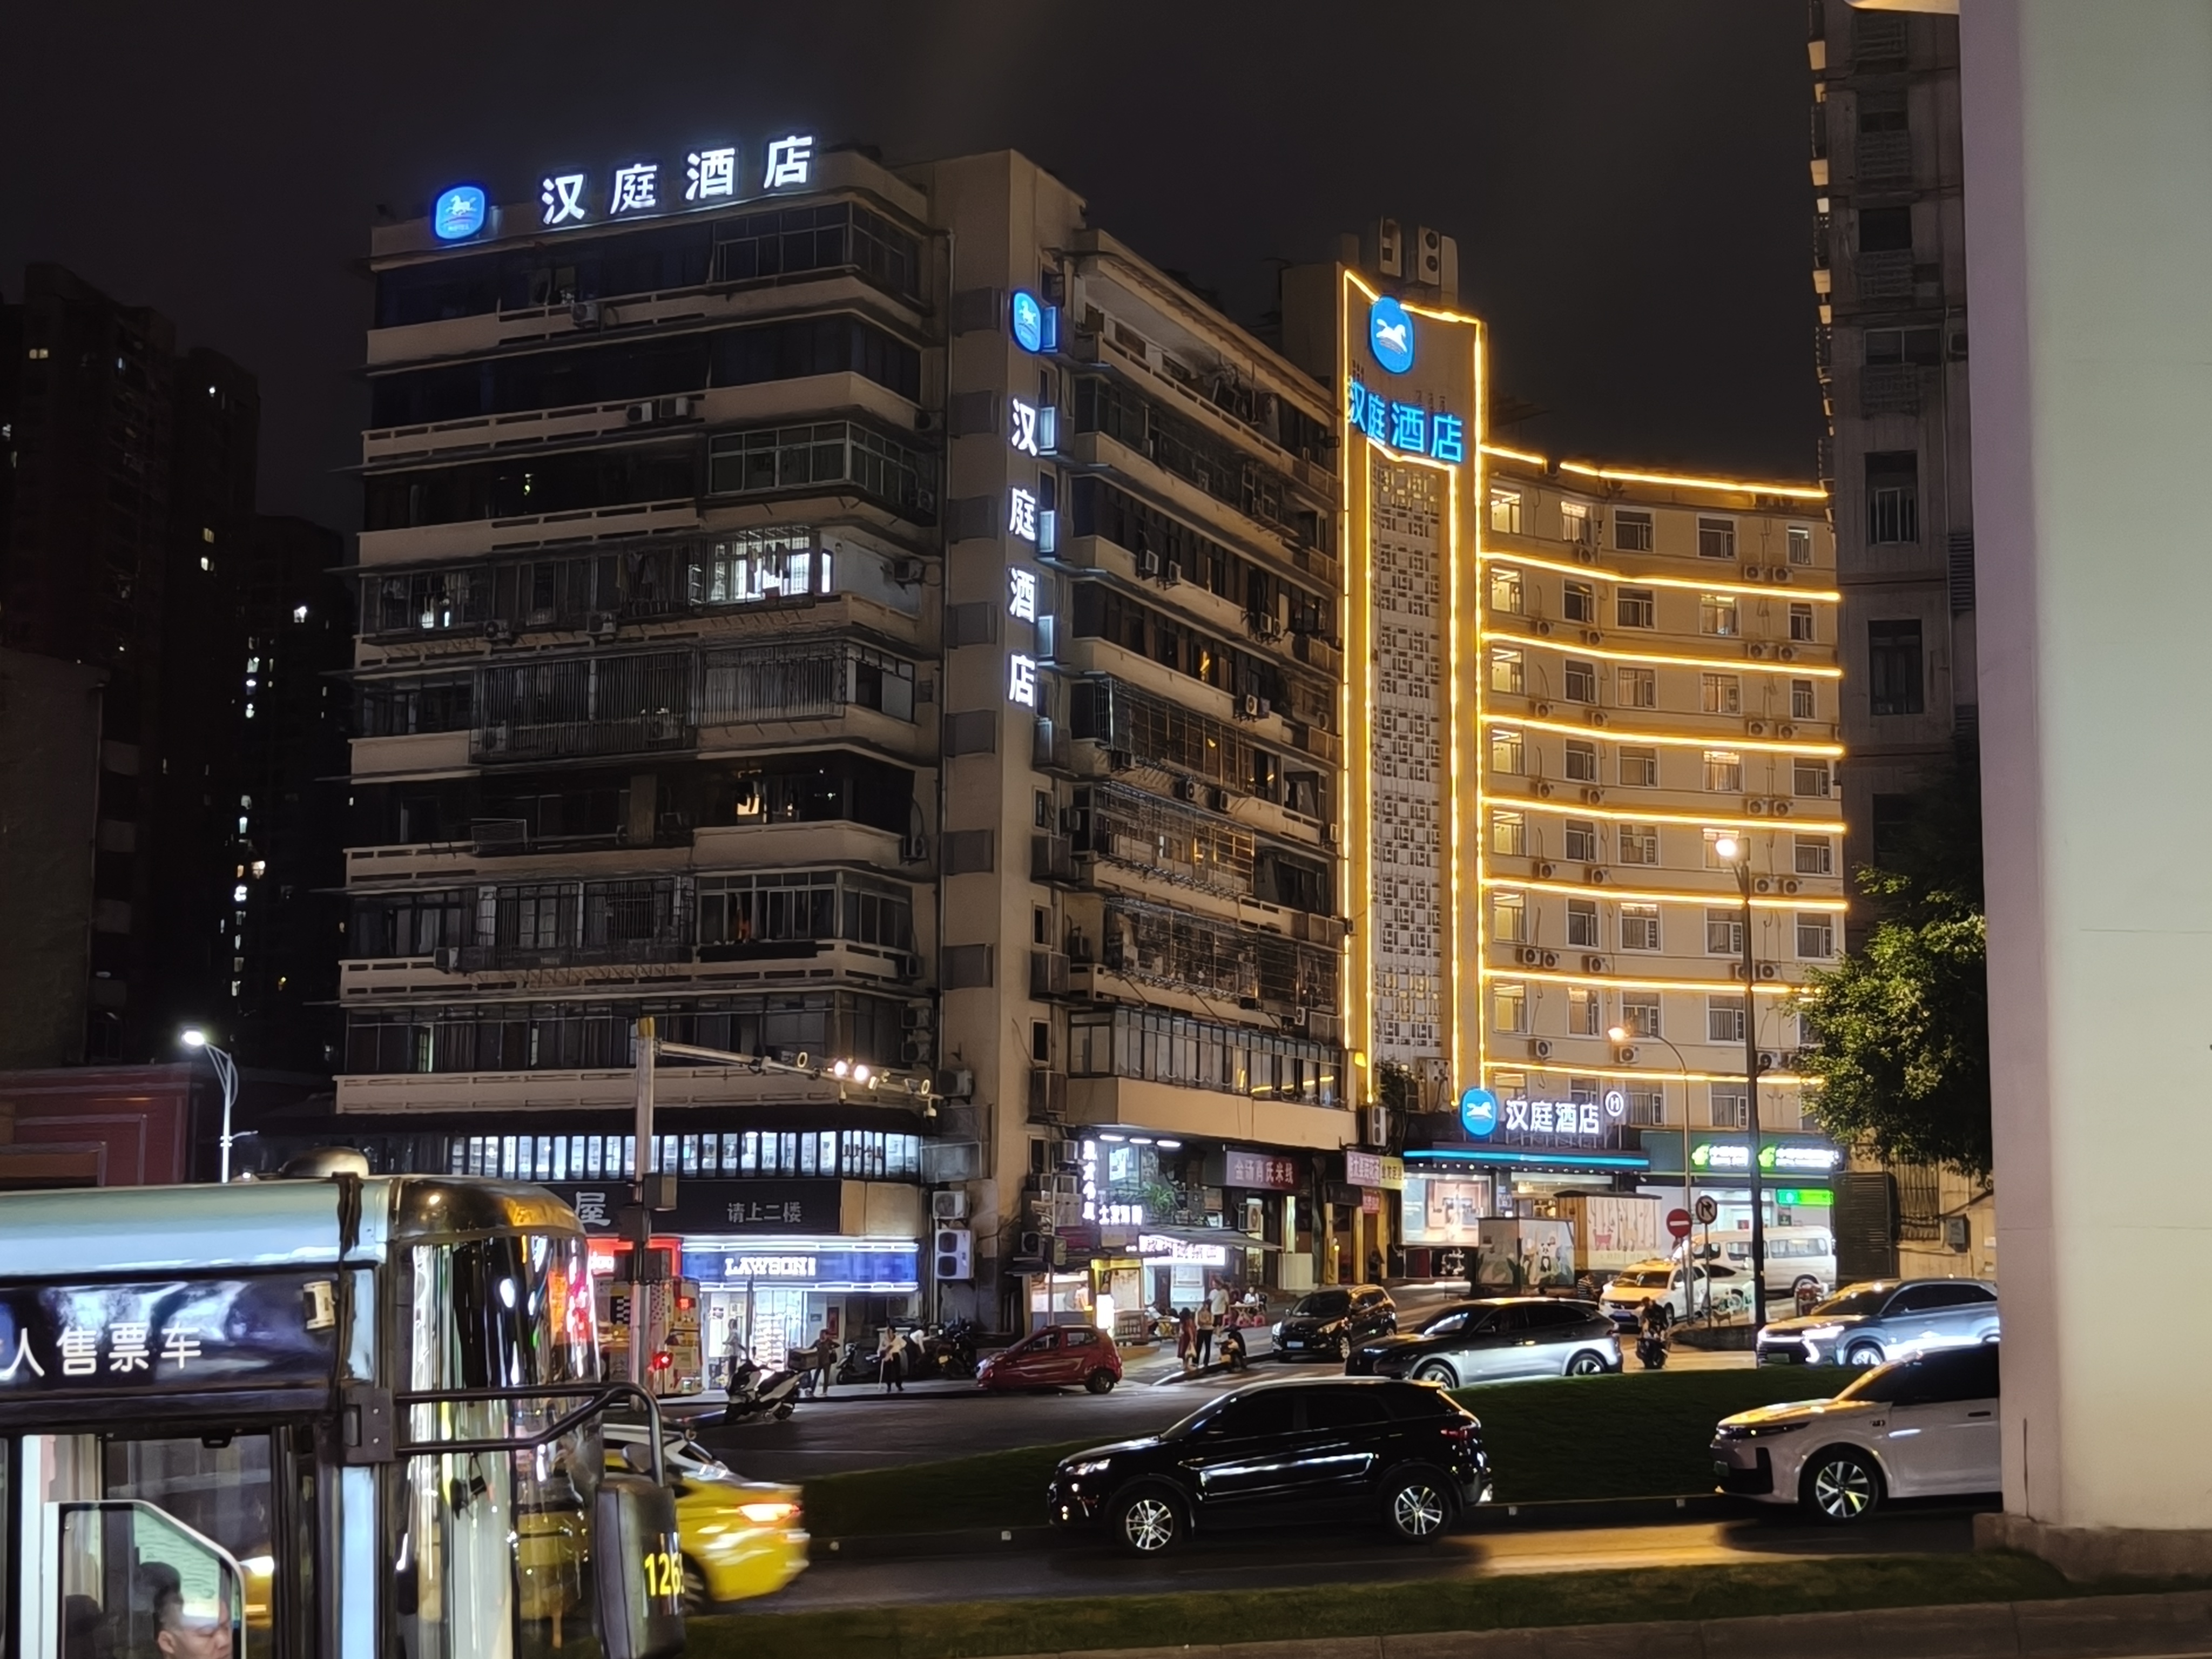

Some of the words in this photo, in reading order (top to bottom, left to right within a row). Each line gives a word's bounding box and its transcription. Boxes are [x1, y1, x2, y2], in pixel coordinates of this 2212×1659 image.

[542, 136, 813, 224] 汉庭酒店
[1348, 376, 1462, 462] 汉庭酒店
[1009, 398, 1037, 707] 汉庭酒店
[1506, 1100, 1599, 1134] 汉庭酒店
[575, 1191, 611, 1226] 屋
[727, 1202, 802, 1223] 请上二楼
[725, 1257, 808, 1277] LAWSON
